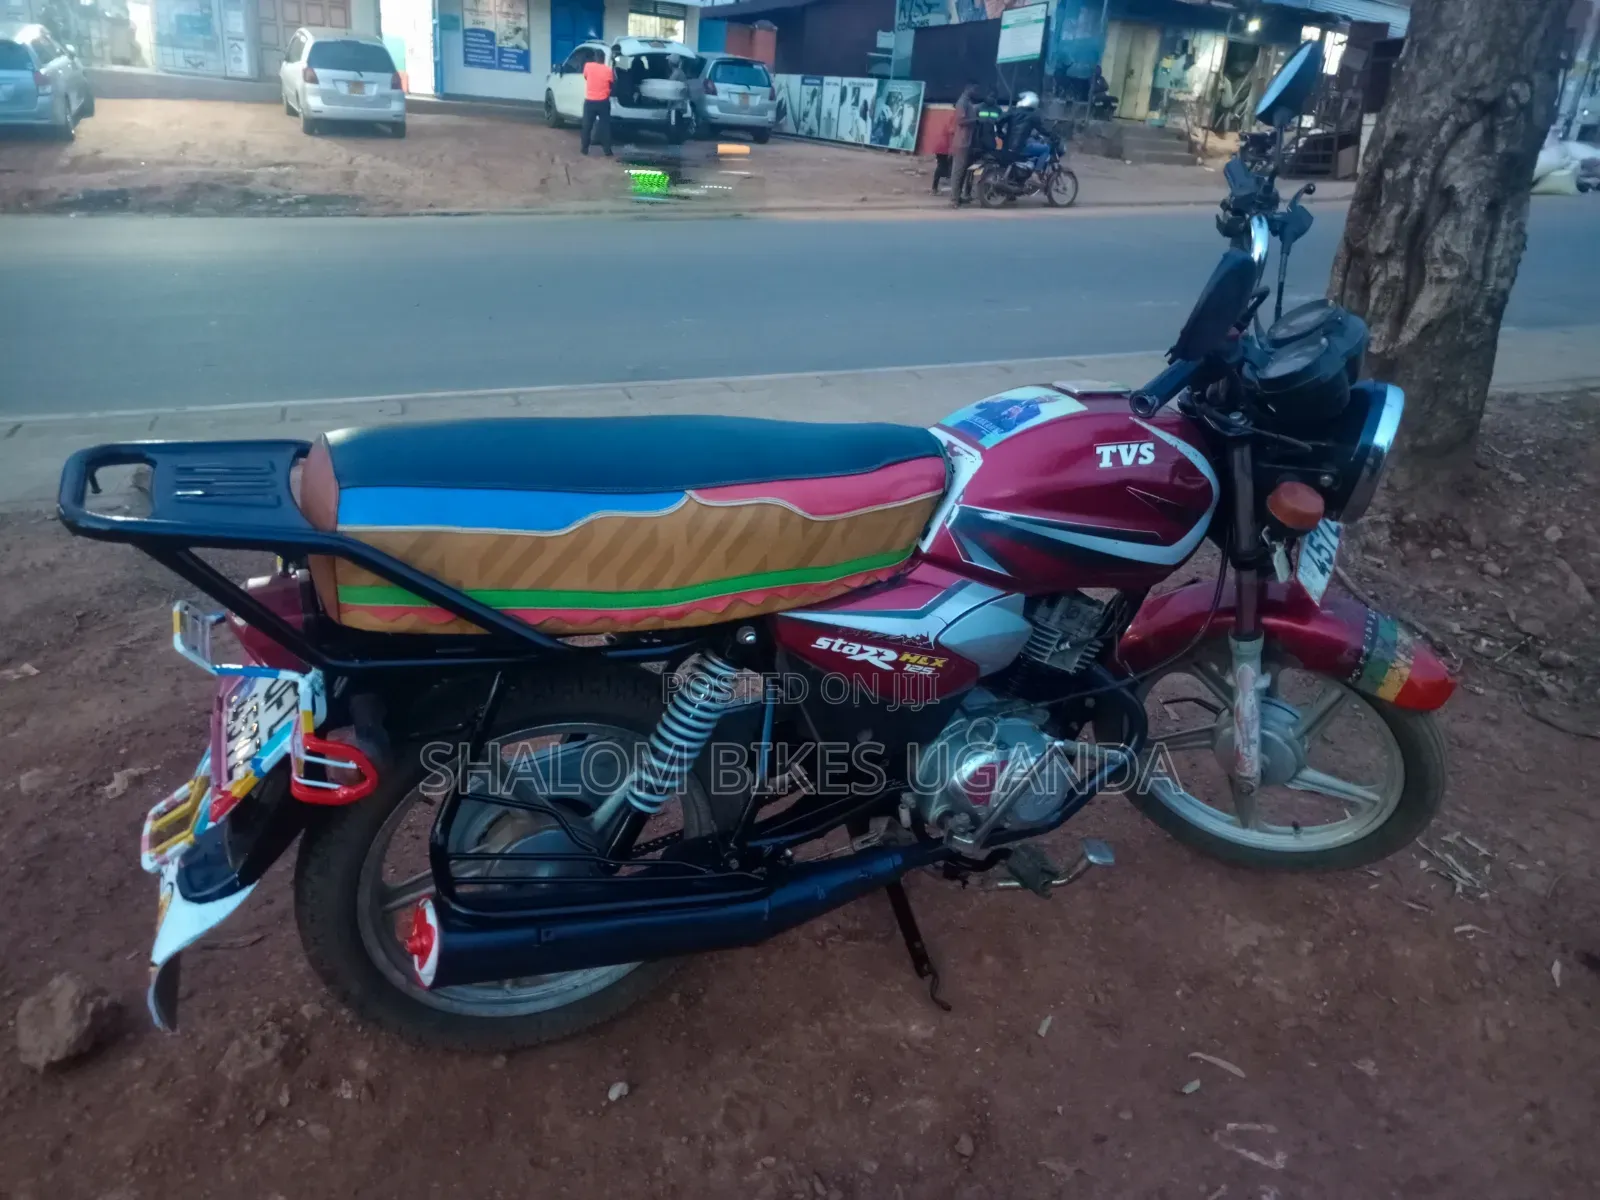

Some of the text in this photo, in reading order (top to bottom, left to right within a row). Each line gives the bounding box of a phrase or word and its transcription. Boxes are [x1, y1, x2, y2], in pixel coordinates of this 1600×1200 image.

[1095, 442, 1155, 468] TVS
[899, 652, 949, 667] HLX
[903, 664, 936, 675] 125
